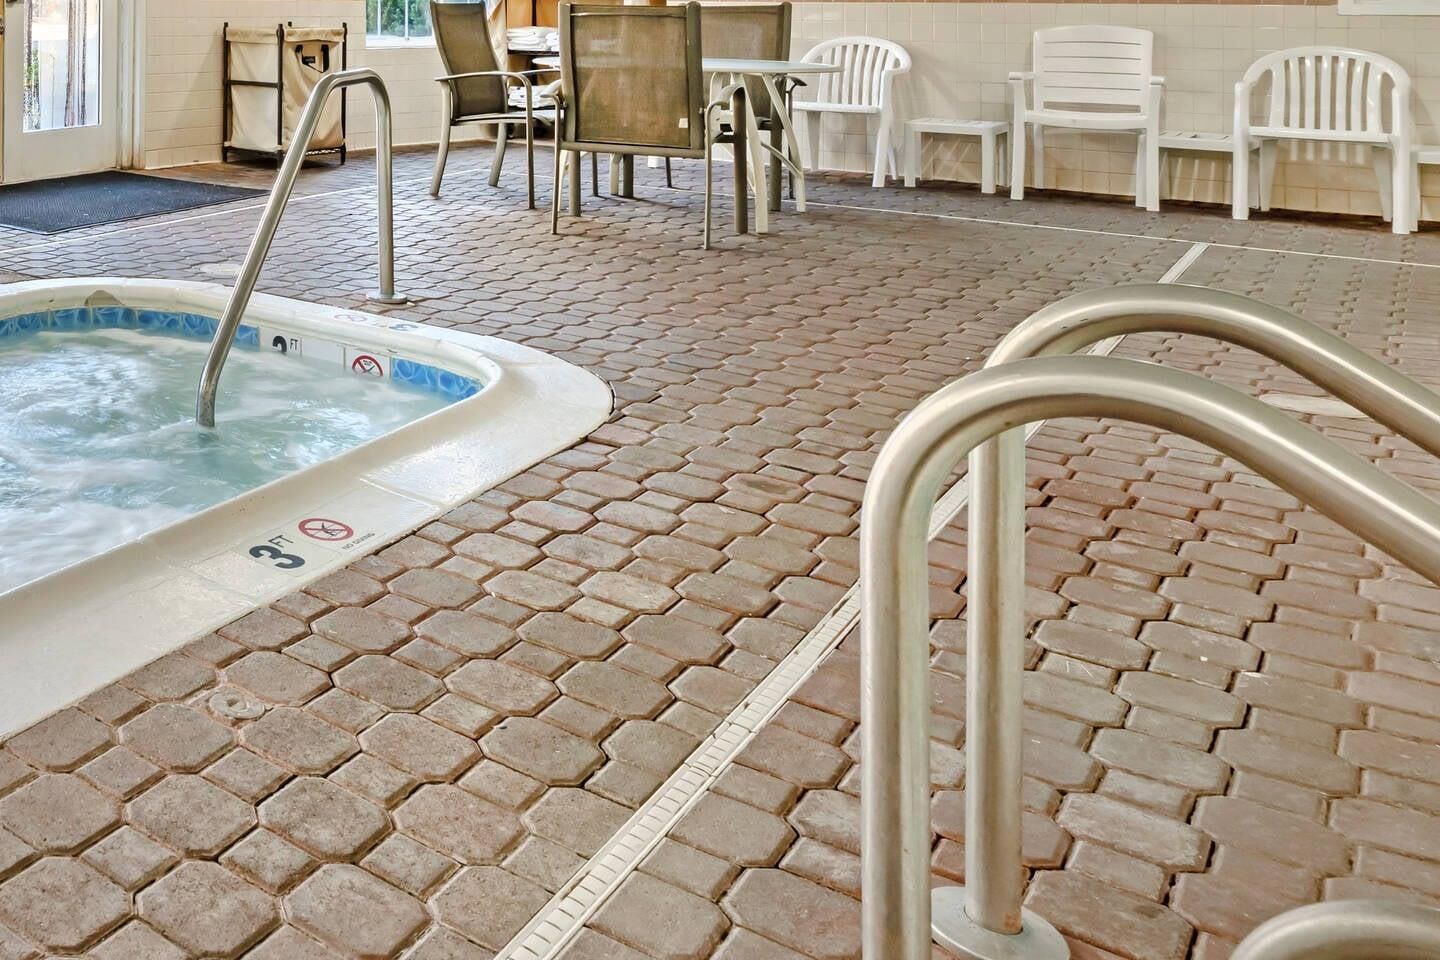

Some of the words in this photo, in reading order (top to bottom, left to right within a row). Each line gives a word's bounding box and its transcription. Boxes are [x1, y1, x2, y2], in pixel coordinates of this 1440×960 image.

[289, 338, 299, 351] FT
[267, 534, 294, 549] FT
[248, 544, 306, 570] 3
